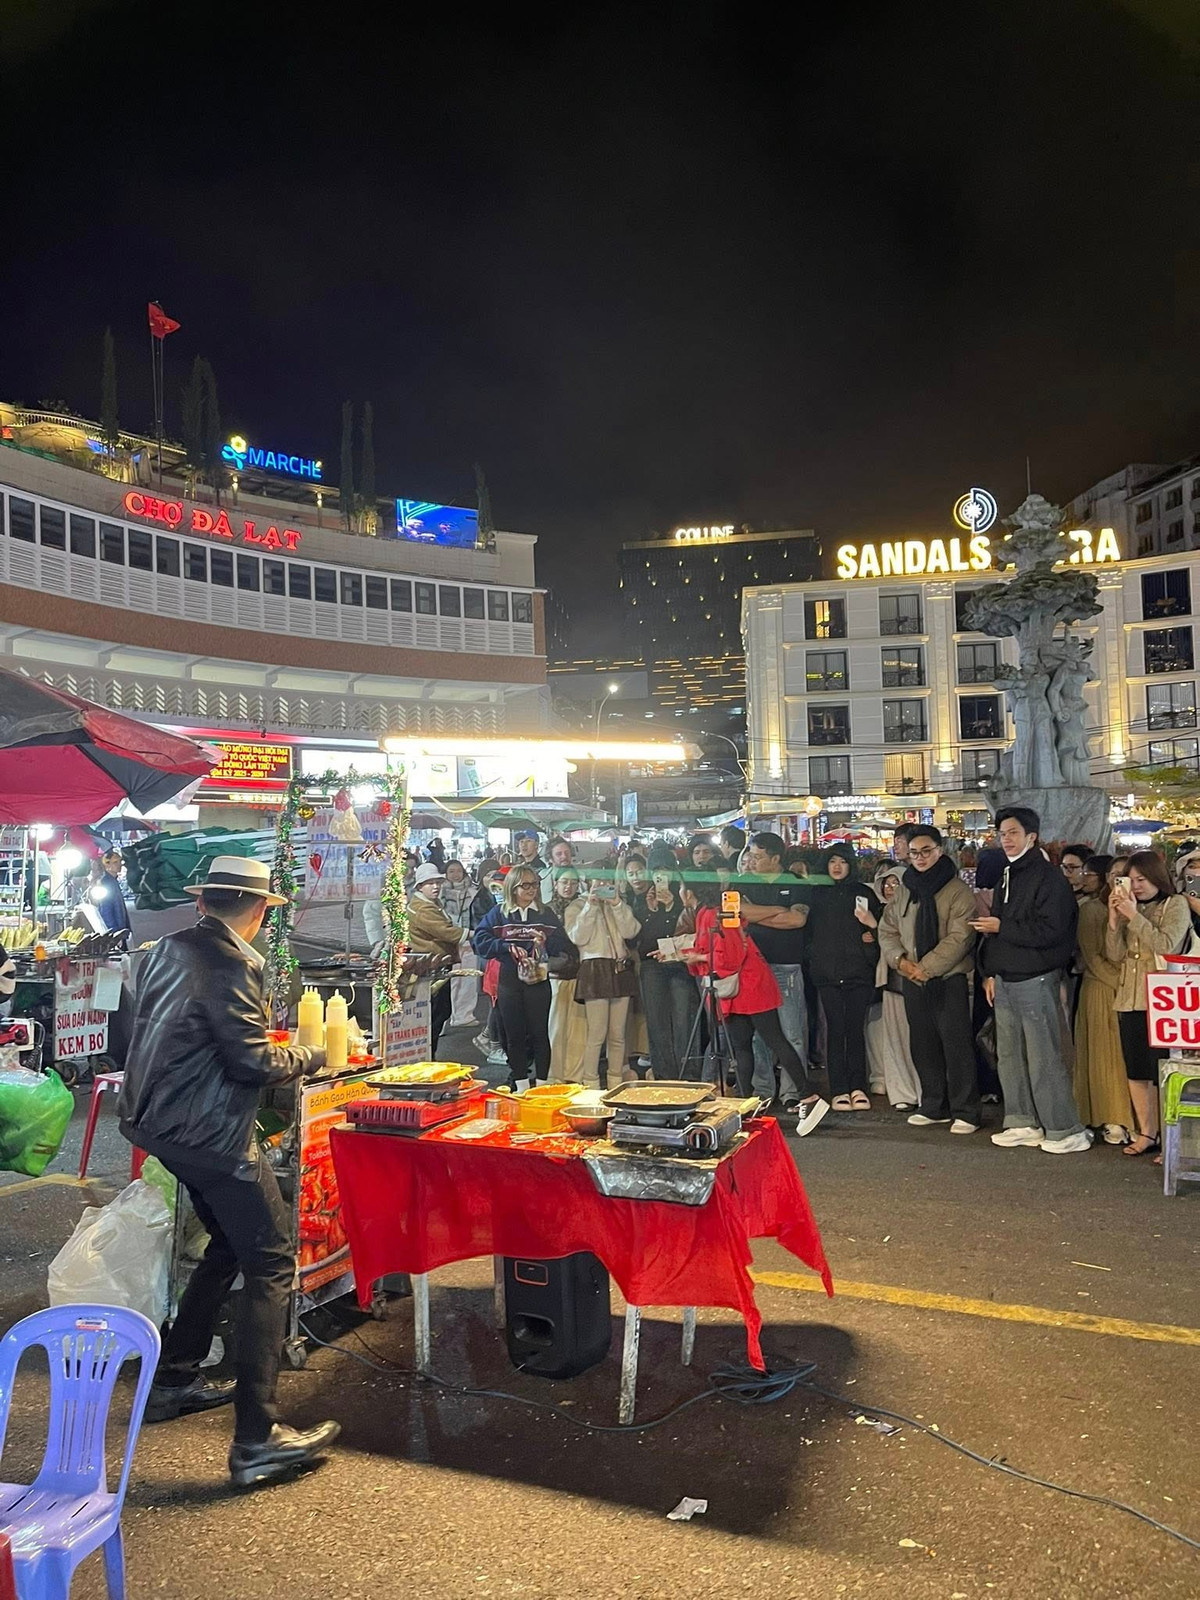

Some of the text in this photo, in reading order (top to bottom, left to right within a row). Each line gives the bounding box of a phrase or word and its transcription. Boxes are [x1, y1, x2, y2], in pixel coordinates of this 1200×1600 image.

[125, 491, 301, 551] CHỢ ĐÀ LẠT
[837, 534, 992, 580] SANDALS
[58, 1029, 105, 1056] KEM BƠ
[310, 1094, 329, 1108] Bánh
